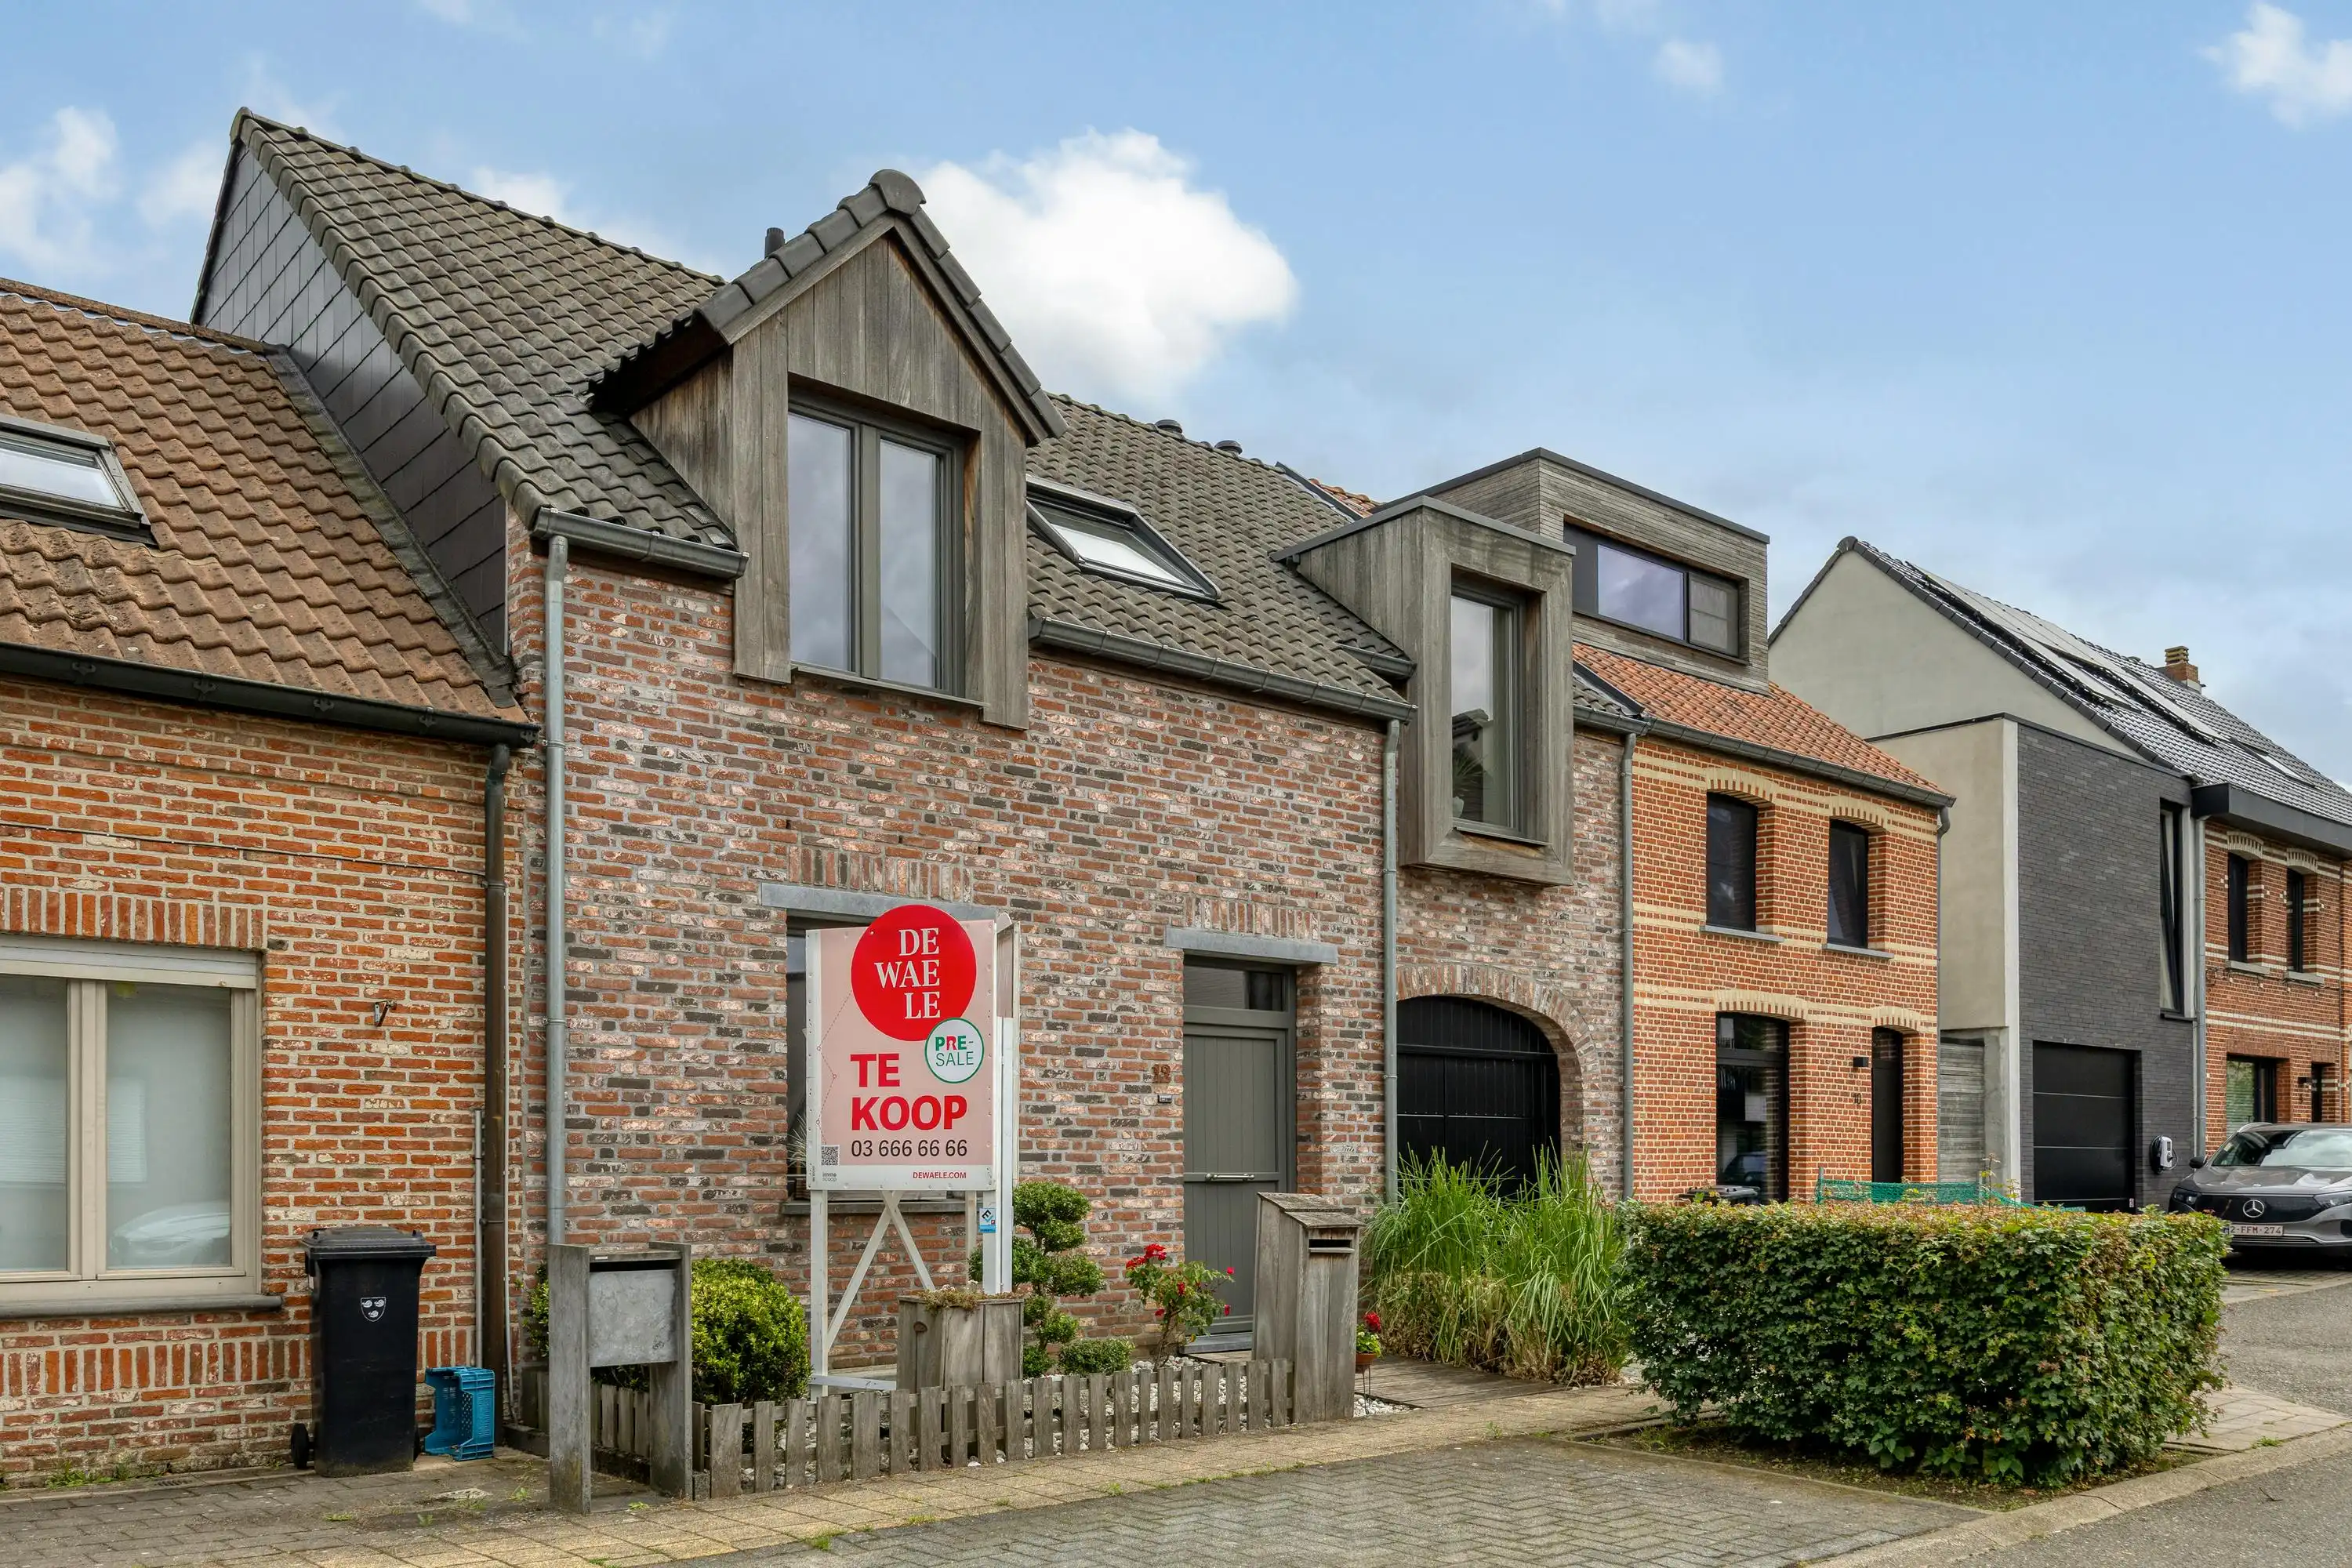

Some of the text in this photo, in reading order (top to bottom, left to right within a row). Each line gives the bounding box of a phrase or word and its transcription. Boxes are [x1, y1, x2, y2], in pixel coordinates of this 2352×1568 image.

[898, 927, 939, 956] DE
[874, 959, 940, 989] WAE
[904, 991, 941, 1019] LE
[935, 1035, 974, 1051] PRE-
[850, 1053, 900, 1087] TE
[935, 1051, 974, 1067] SALE
[851, 1094, 967, 1131] KOOP
[851, 1139, 967, 1156] 03 666 66 66
